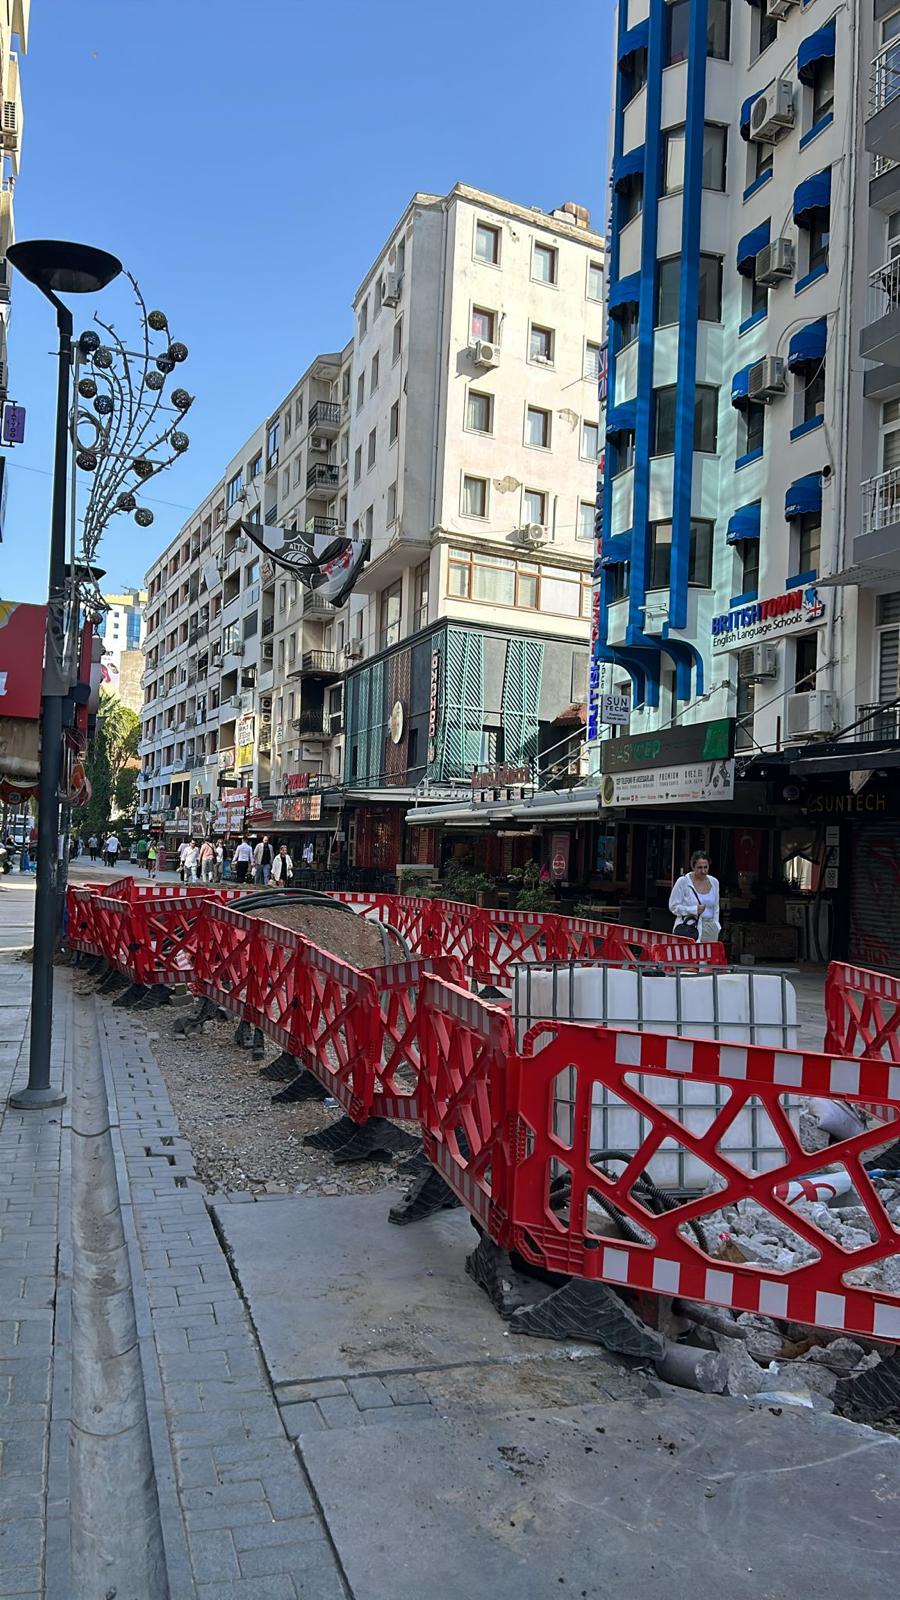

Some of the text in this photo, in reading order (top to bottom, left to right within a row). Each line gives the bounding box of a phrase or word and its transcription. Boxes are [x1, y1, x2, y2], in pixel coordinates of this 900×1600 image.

[289, 542, 309, 553] ALTAY
[713, 612, 803, 647] English Language Schools
[606, 696, 628, 706] SUN
[816, 793, 886, 812] SUNTECH
